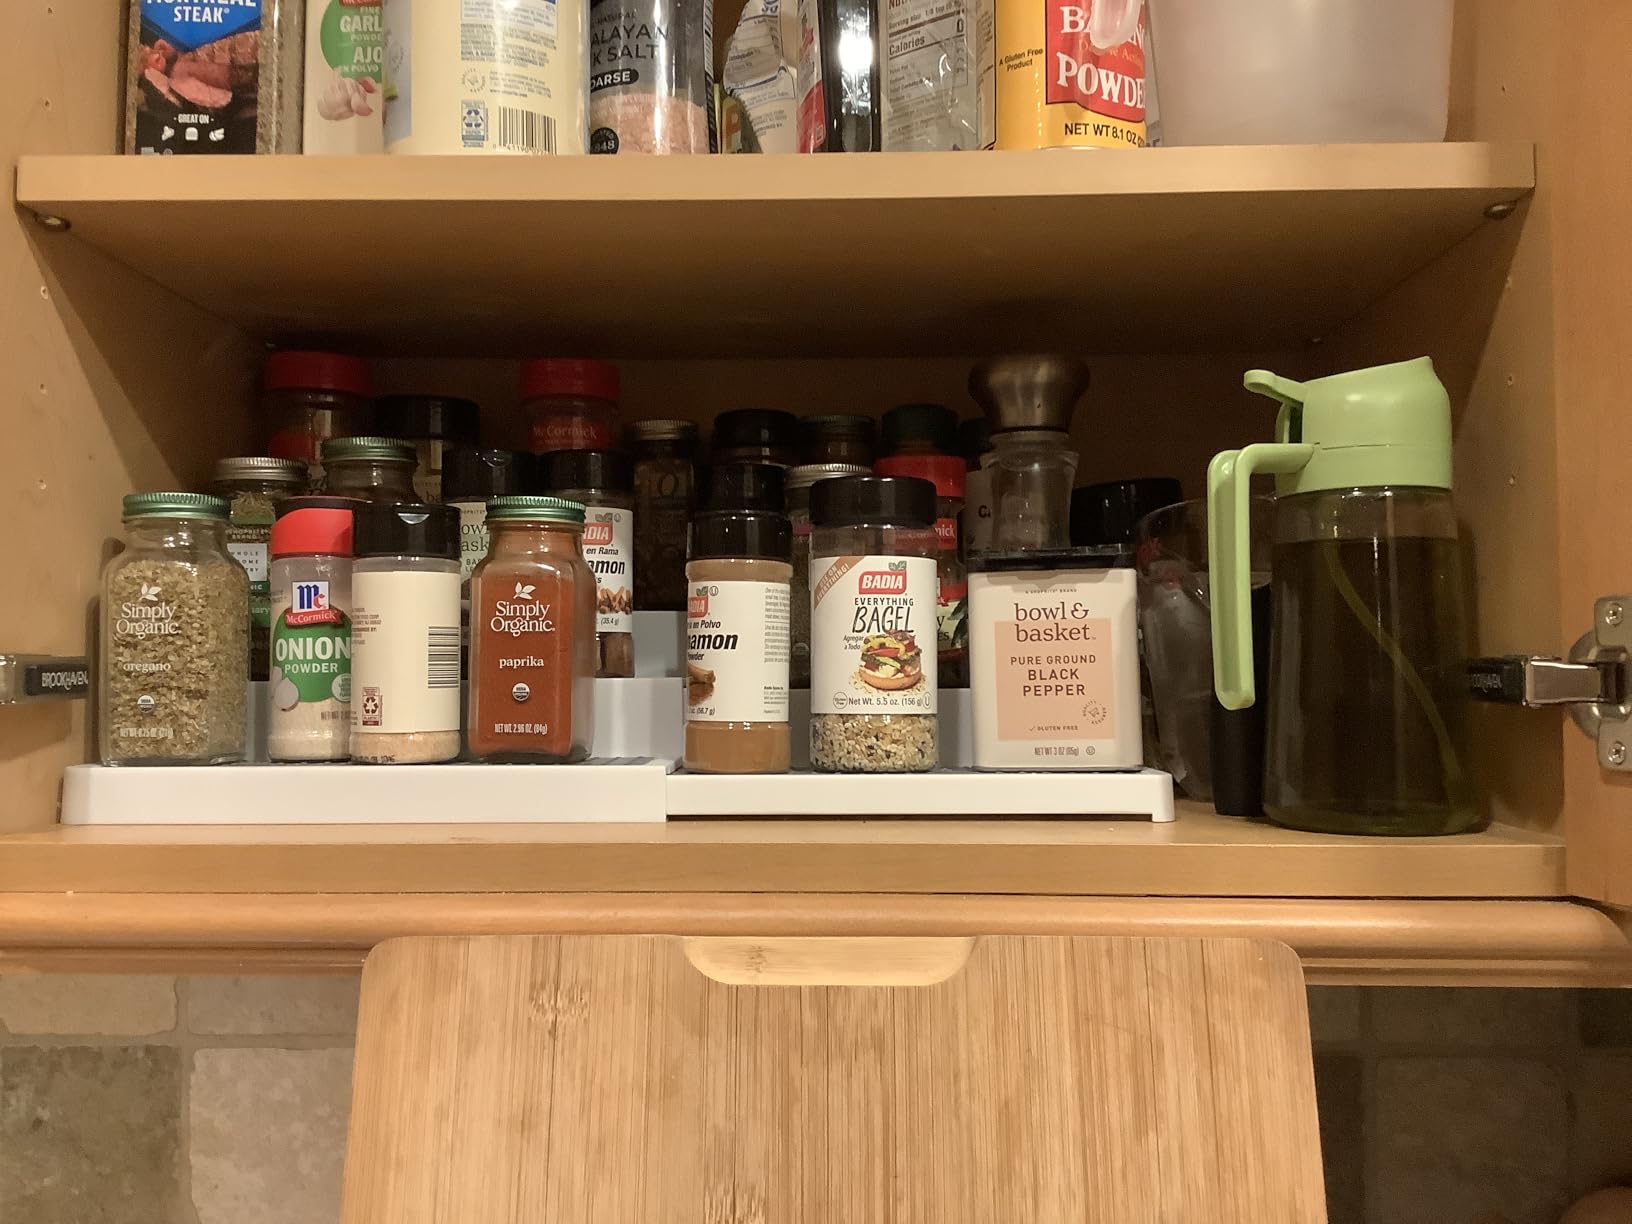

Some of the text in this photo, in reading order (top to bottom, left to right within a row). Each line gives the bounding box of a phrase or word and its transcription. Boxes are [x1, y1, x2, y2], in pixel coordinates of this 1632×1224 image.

[340, 15, 383, 33] GARL
[591, 23, 669, 46] ALAYAN
[607, 44, 660, 62] SALT
[889, 36, 925, 56] Calories
[1004, 51, 1026, 64] Gluten
[1027, 48, 1043, 59] Free
[1006, 58, 1033, 72] Product
[1056, 52, 1146, 109] POWDE
[178, 113, 198, 124] GREAT
[1064, 123, 1089, 136] NET
[1093, 124, 1110, 137] WT
[1111, 126, 1124, 140] 8.1
[1126, 129, 1137, 145] OZ
[461, 536, 488, 552] ask
[598, 547, 619, 556] Rama
[588, 559, 625, 575] amon
[861, 575, 903, 590] BADIA
[854, 597, 914, 606] EVERYTHING
[120, 602, 177, 621] Simply
[285, 610, 337, 624] McCormick
[495, 600, 550, 622] Simply
[1014, 601, 1089, 622] bowl &
[490, 616, 553, 637] Organic
[700, 619, 721, 629] Polvo
[852, 606, 915, 633] BAGEL
[115, 619, 179, 640] Organic
[1014, 623, 1090, 643] basket
[843, 634, 864, 643] Agregar
[275, 636, 351, 661] ONION
[499, 655, 545, 668] paprika
[1010, 654, 1097, 666] PURE GROUND
[123, 662, 172, 674] oregano
[284, 662, 339, 674] POWDER
[1028, 668, 1080, 681] BLACK
[1023, 684, 1086, 697] PEPPER
[848, 697, 861, 706] Net
[862, 697, 874, 706] Wt.
[876, 697, 888, 706] 5.5
[901, 697, 916, 706] (156
[494, 723, 504, 733] NET
[1034, 746, 1044, 756] NET
[1044, 746, 1053, 756] WT
